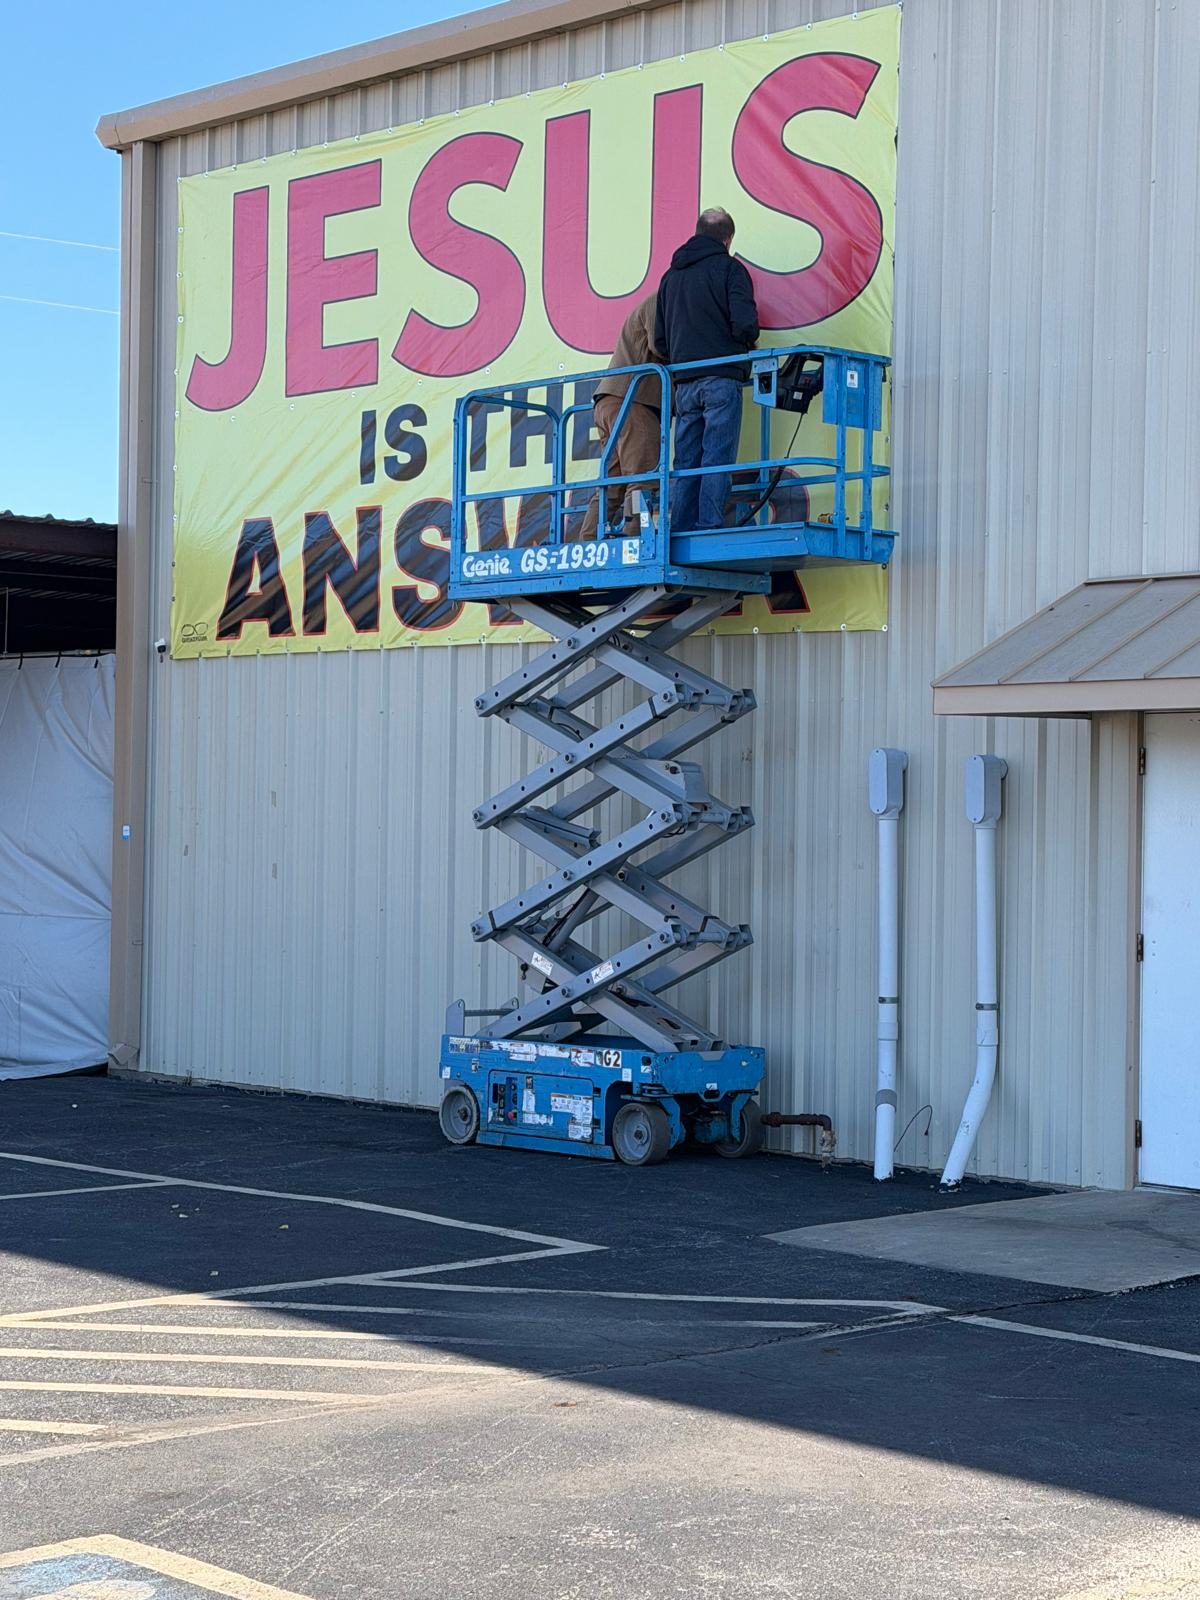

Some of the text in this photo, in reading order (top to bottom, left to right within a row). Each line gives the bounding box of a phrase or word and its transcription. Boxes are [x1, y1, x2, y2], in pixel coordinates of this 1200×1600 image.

[185, 51, 883, 412] JESUS
[359, 402, 428, 485] IS
[462, 542, 609, 578] Genie GS-1930
